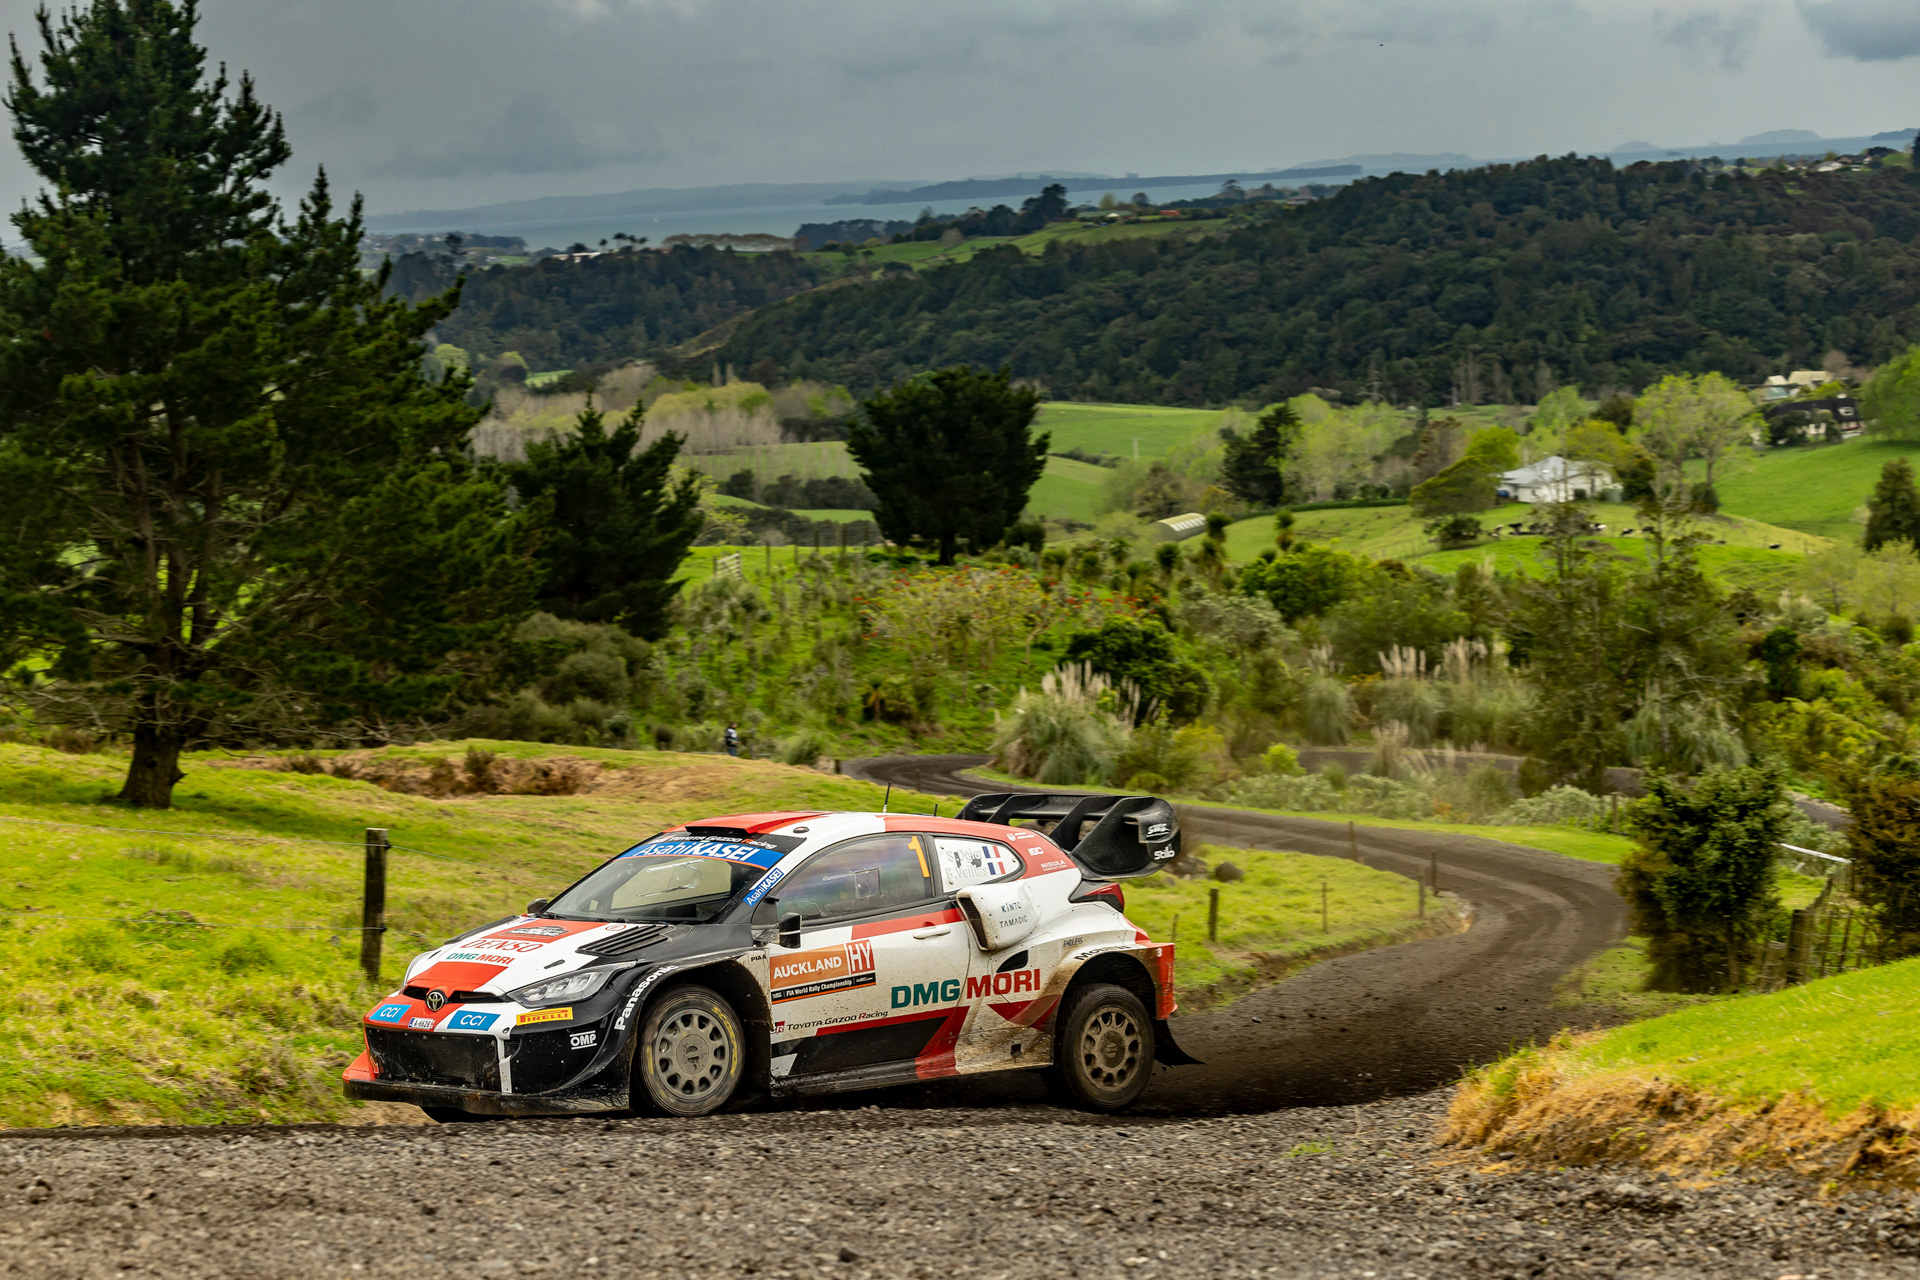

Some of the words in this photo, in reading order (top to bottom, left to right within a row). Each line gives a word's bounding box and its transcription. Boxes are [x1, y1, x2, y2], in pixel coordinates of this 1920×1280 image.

[907, 836, 930, 878] 1
[1153, 843, 1176, 860] Stilo
[745, 869, 784, 906] AsahiKASEI
[999, 915, 1028, 928] TAMADIC
[459, 940, 544, 953] DENSO
[1063, 937, 1085, 948] ENDLESS
[446, 953, 481, 961] DMG
[475, 954, 516, 965] MORI
[751, 954, 767, 962] PIAA
[773, 956, 843, 980] AUCKLAND
[847, 941, 873, 973] HY
[786, 990, 795, 998] FIA
[795, 987, 808, 996] World
[808, 985, 821, 993] Rally
[821, 979, 852, 991] Championship
[891, 979, 961, 1009] DMG
[966, 968, 1041, 1000] MORI
[614, 965, 679, 1031] Panasonic
[520, 1010, 569, 1023] PIRELLI
[787, 1020, 823, 1031] TOYOTA
[824, 1015, 857, 1025] GAZOO
[858, 1011, 889, 1022] Racing
[570, 1033, 597, 1047] OMP
